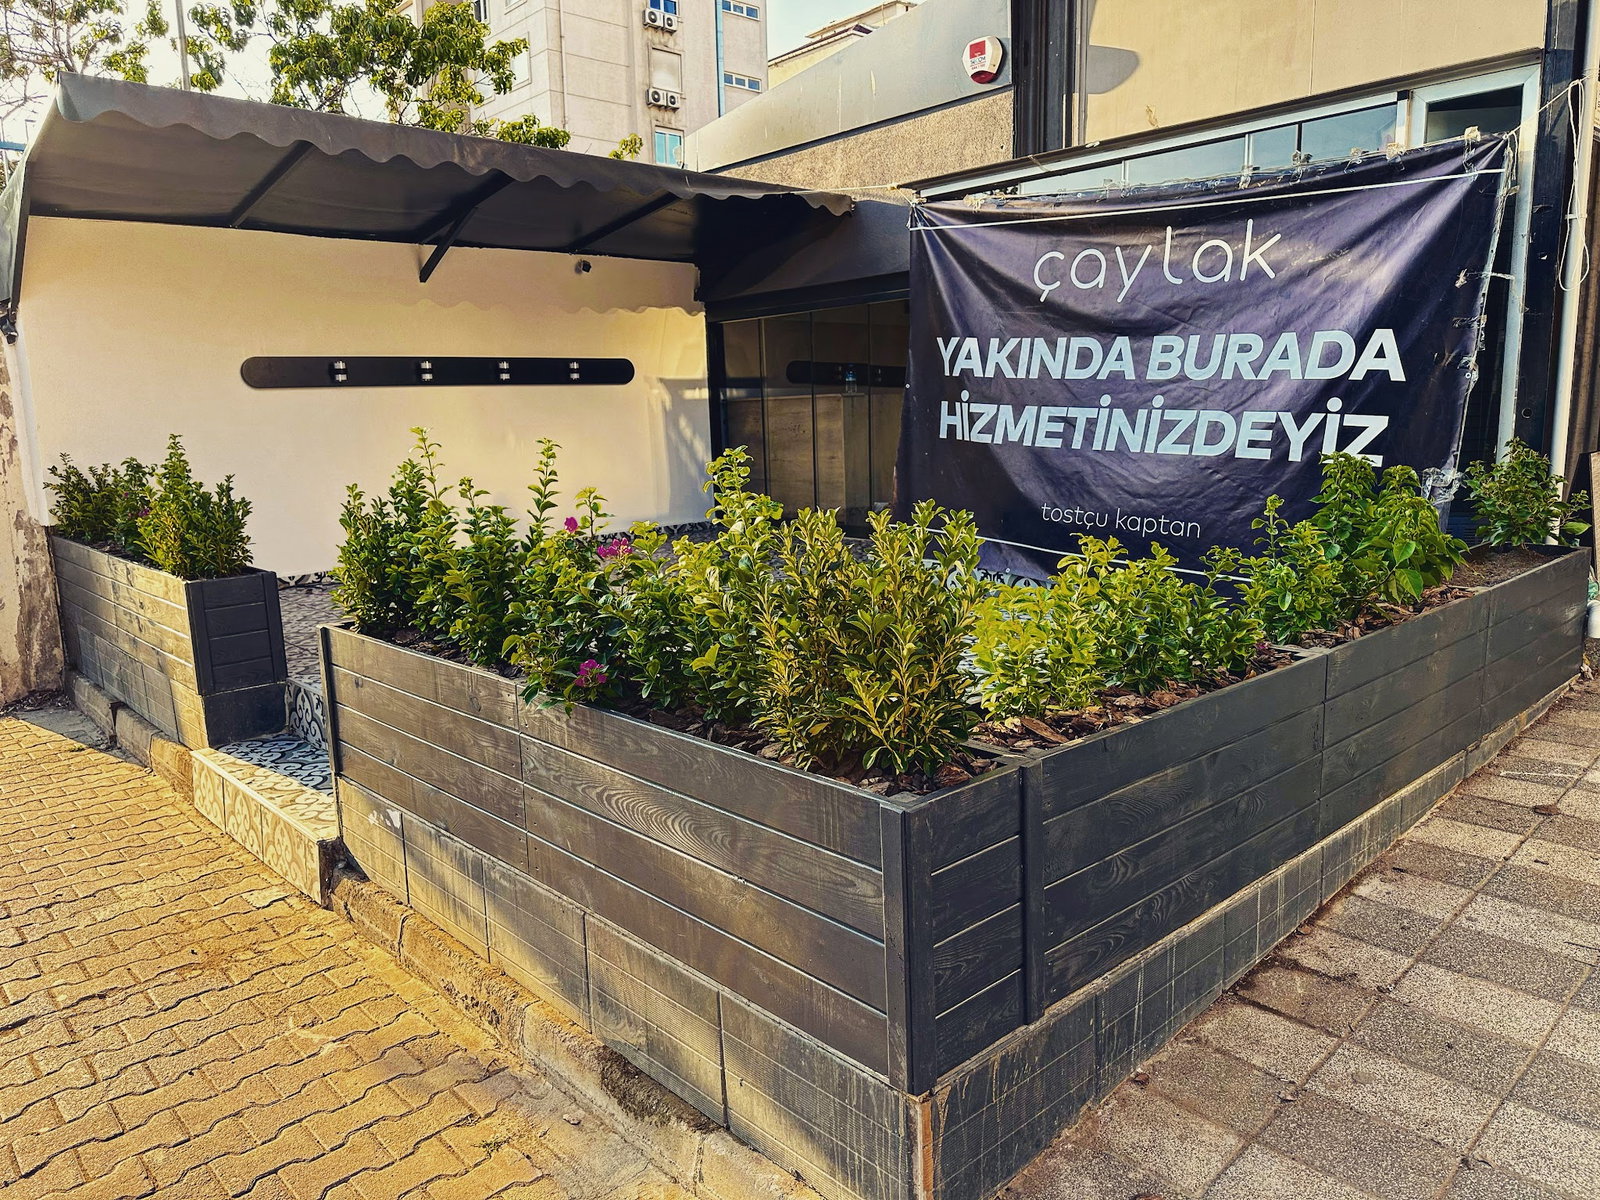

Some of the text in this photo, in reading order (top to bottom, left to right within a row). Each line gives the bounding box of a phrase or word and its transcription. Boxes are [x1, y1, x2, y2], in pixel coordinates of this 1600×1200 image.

[1033, 218, 1282, 303] çaylak
[936, 328, 1407, 382] YAKINDA BURADA
[939, 389, 1389, 468] HİZMETİNİZDEYİZ
[1041, 502, 1201, 539] tostçu kaptan
